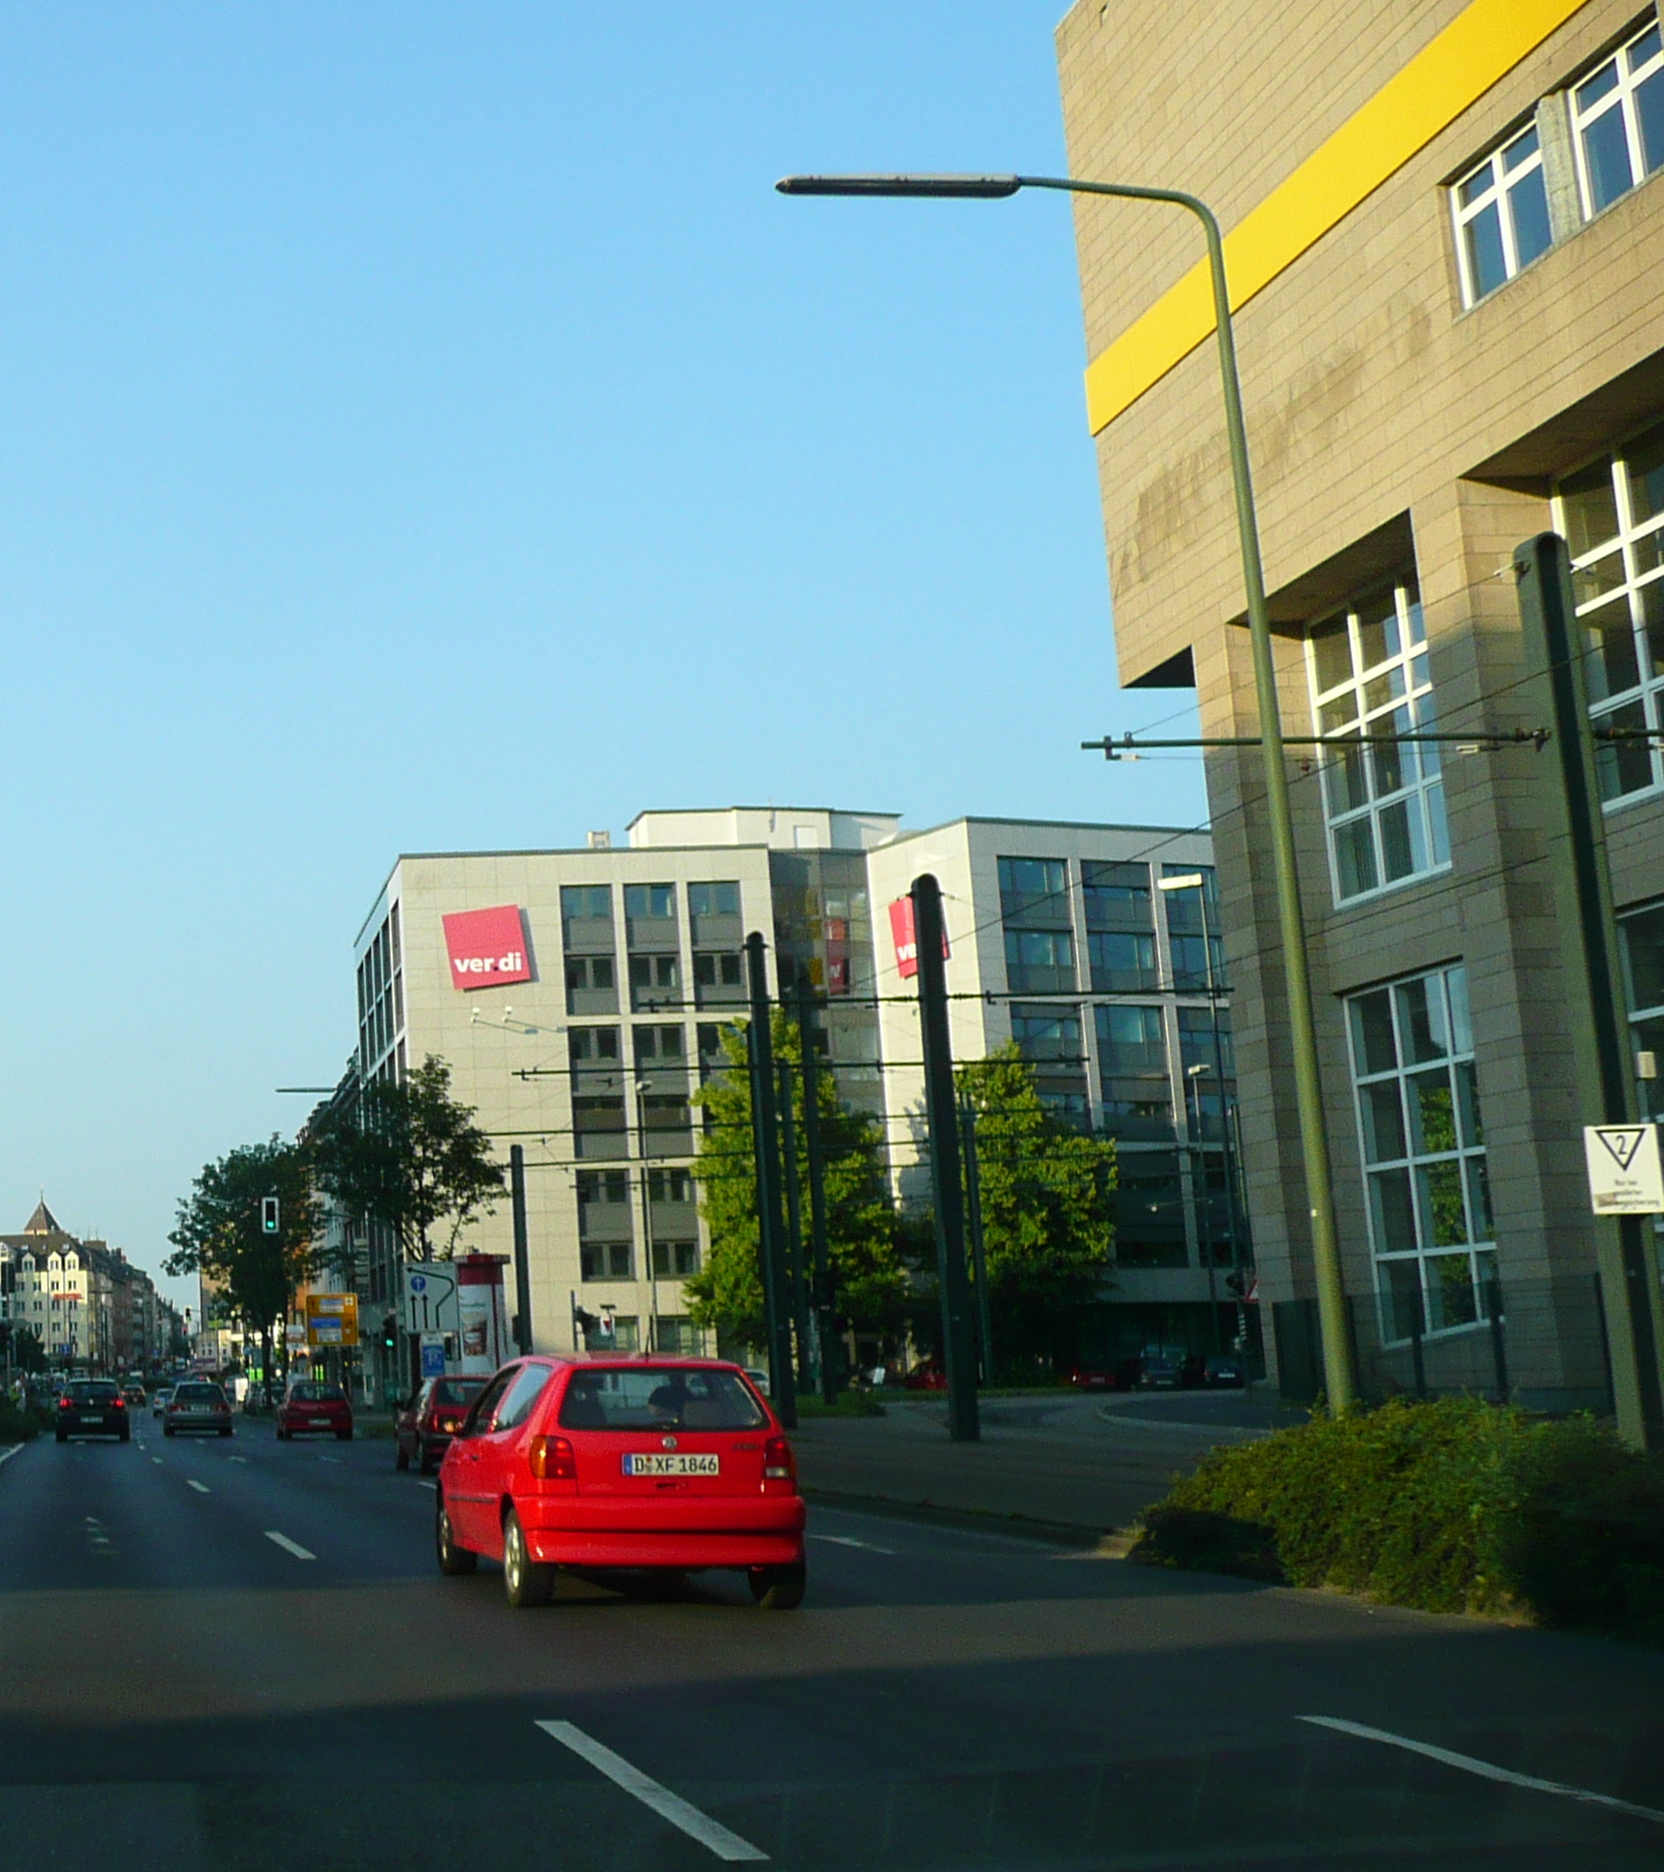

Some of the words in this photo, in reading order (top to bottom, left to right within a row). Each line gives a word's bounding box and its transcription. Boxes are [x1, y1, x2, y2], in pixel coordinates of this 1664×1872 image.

[454, 952, 521, 973] ver.di
[1615, 1134, 1628, 1155] 2
[634, 1457, 645, 1473] D
[655, 1457, 675, 1473] XF
[678, 1457, 718, 1473] 1846
